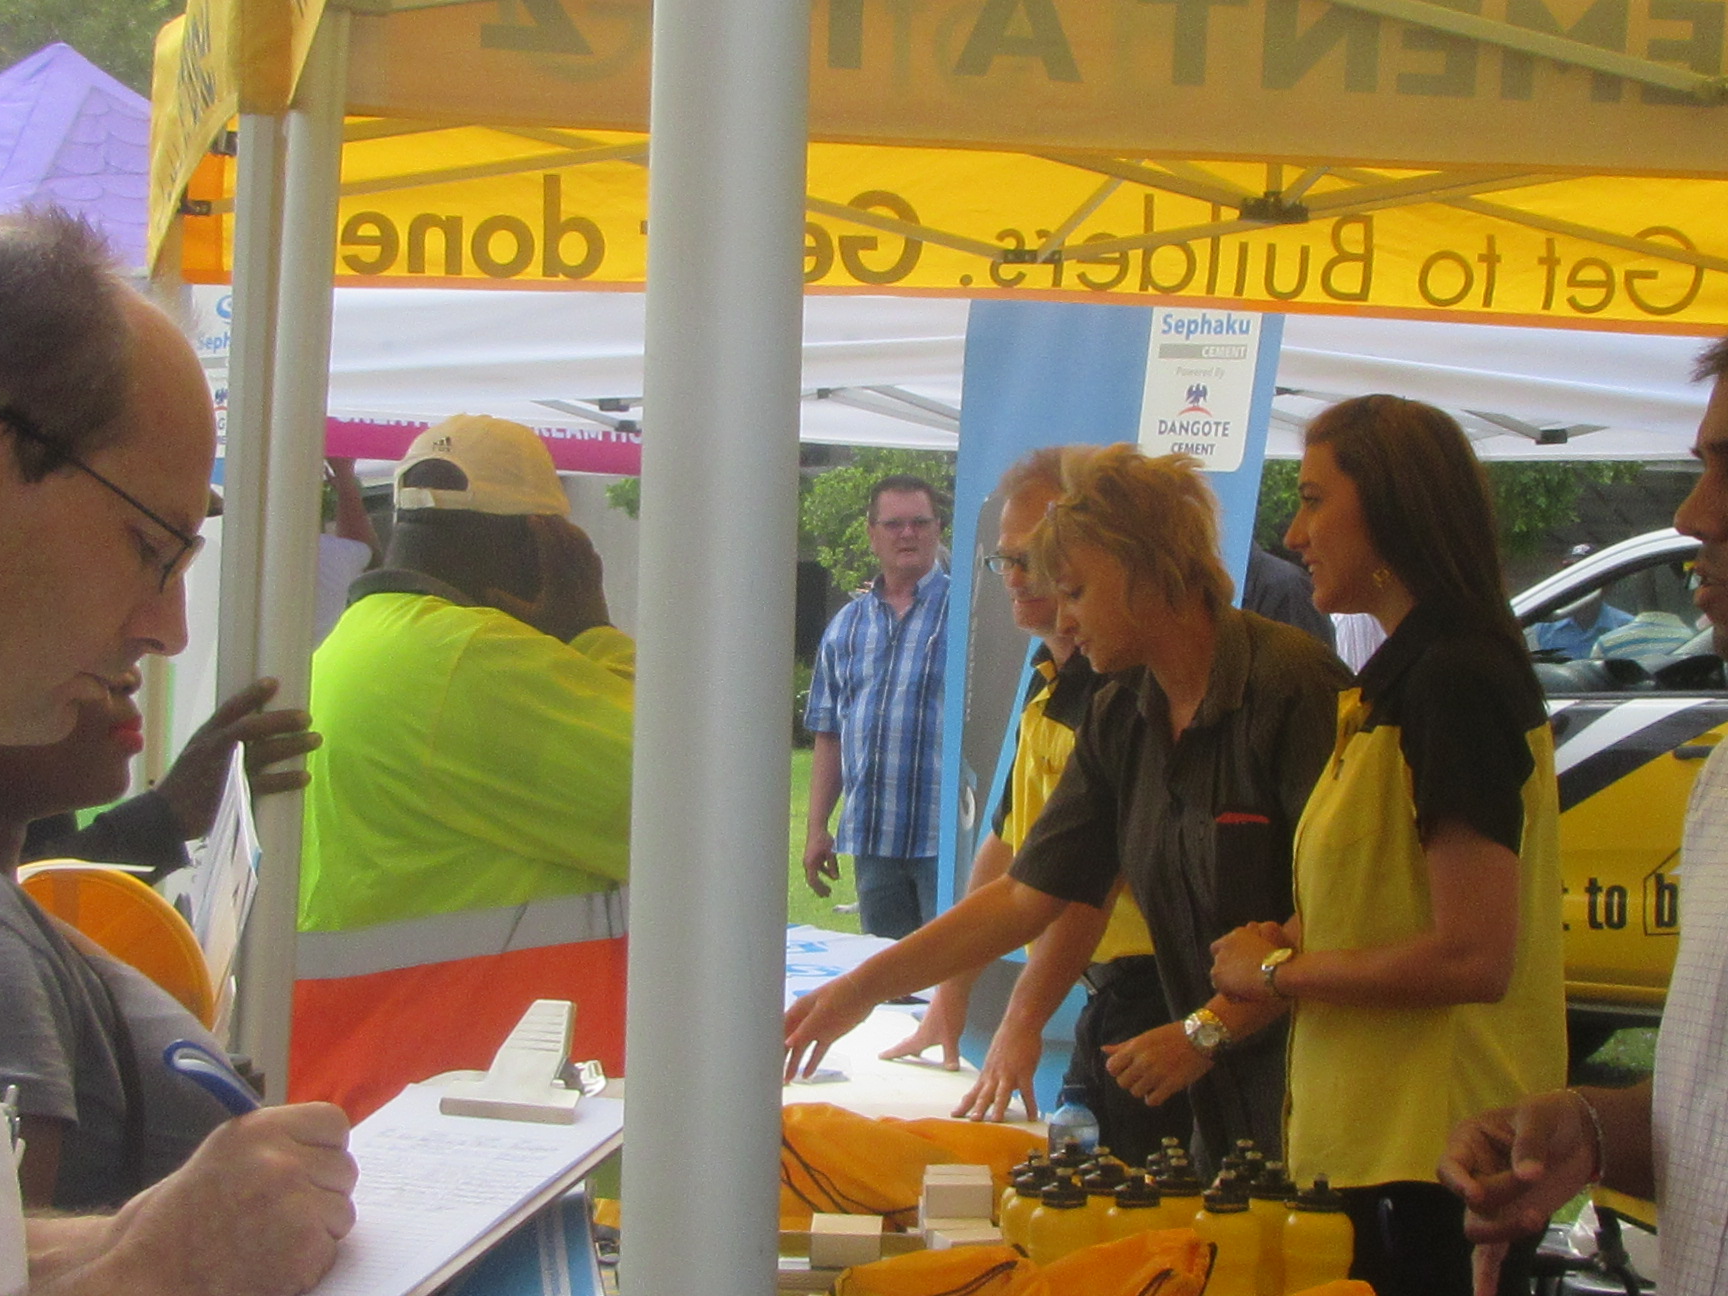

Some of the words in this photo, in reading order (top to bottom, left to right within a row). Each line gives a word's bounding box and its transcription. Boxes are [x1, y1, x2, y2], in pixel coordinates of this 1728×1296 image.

[1161, 313, 1252, 341] Sephaku
[1201, 345, 1247, 359] CEMENT
[1158, 419, 1231, 438] DANGOTE
[1171, 442, 1216, 455] CEMENT
[1584, 877, 1628, 931] to
